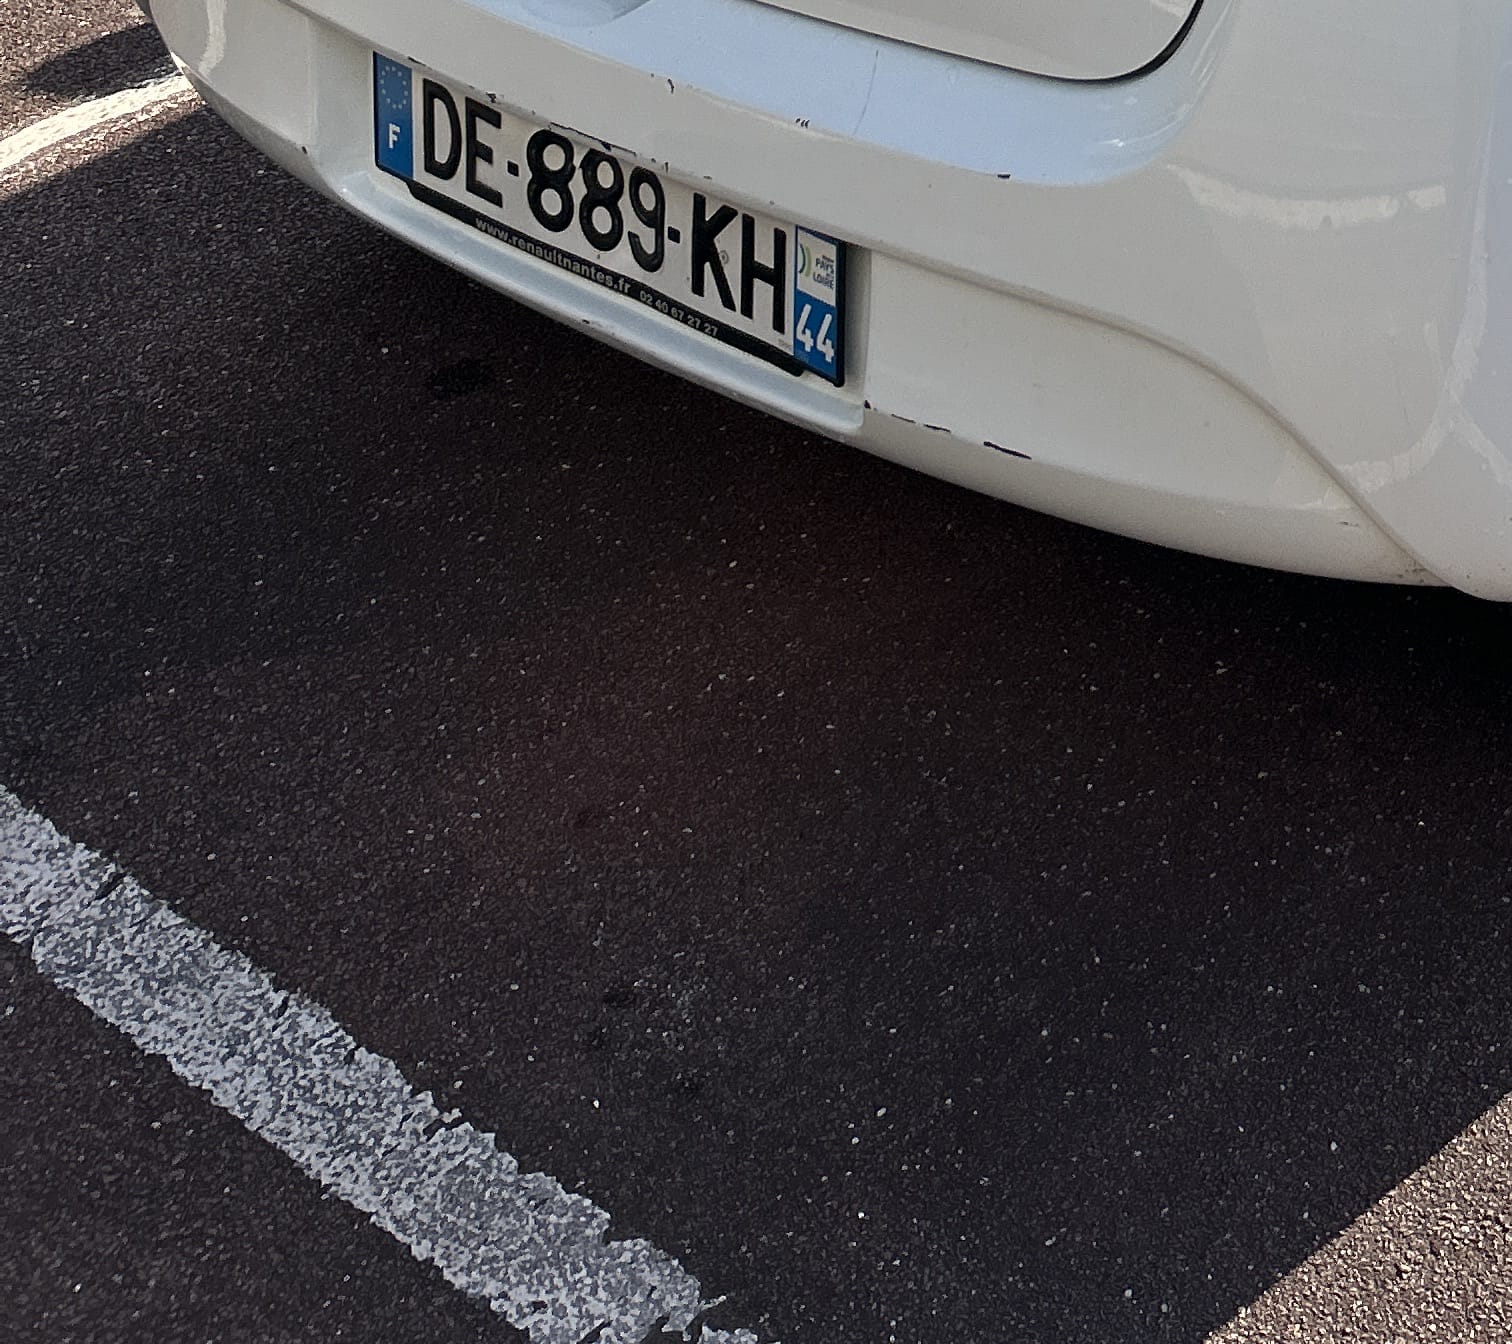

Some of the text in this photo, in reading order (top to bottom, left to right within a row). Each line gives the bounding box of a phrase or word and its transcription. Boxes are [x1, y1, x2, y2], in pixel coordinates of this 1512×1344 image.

[387, 122, 401, 150] F
[421, 77, 787, 336] DE-889-KH
[474, 216, 632, 294] www.renaultnantes.fr
[816, 258, 834, 274] PAYS
[640, 290, 718, 337] 02 40 67 27 27
[796, 302, 834, 363] 44
